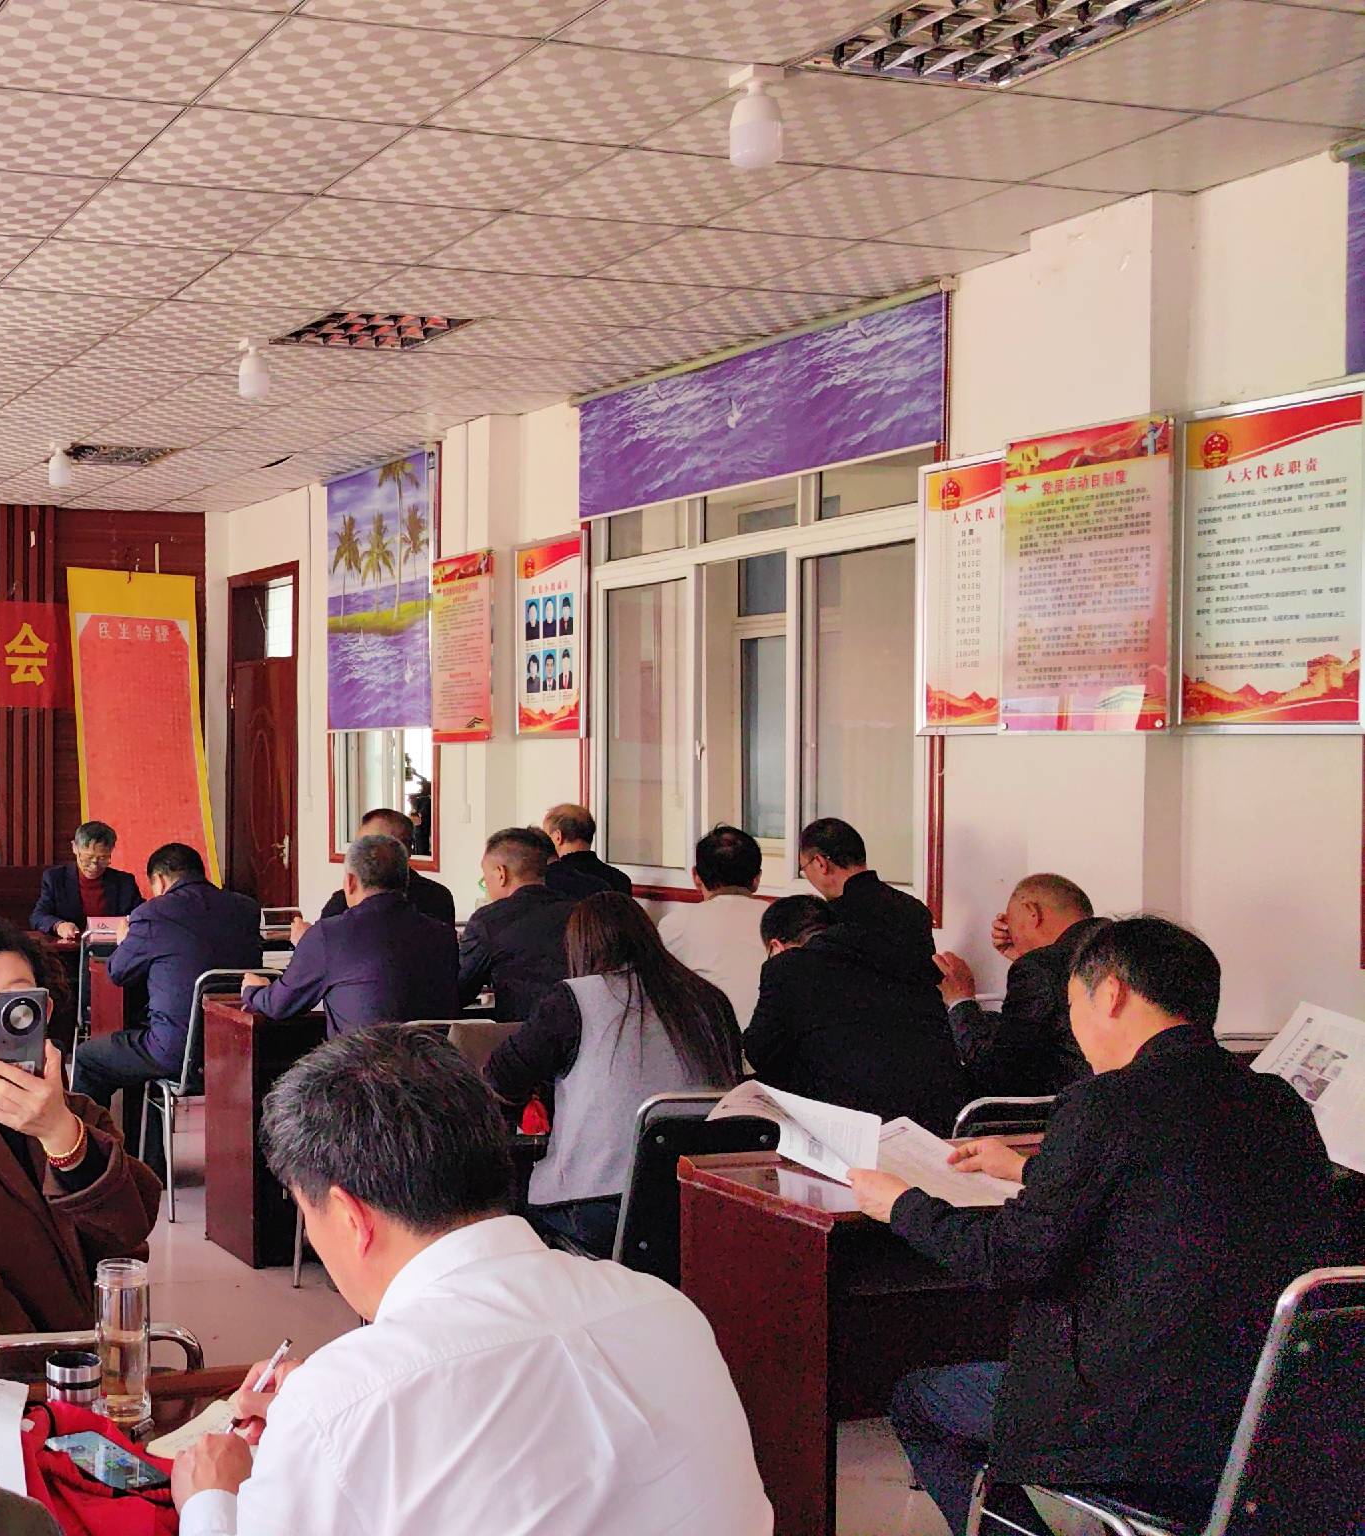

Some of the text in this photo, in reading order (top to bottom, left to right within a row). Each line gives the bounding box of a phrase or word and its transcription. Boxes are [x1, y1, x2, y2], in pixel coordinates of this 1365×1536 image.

[1224, 457, 1319, 484] 人大代表职责
